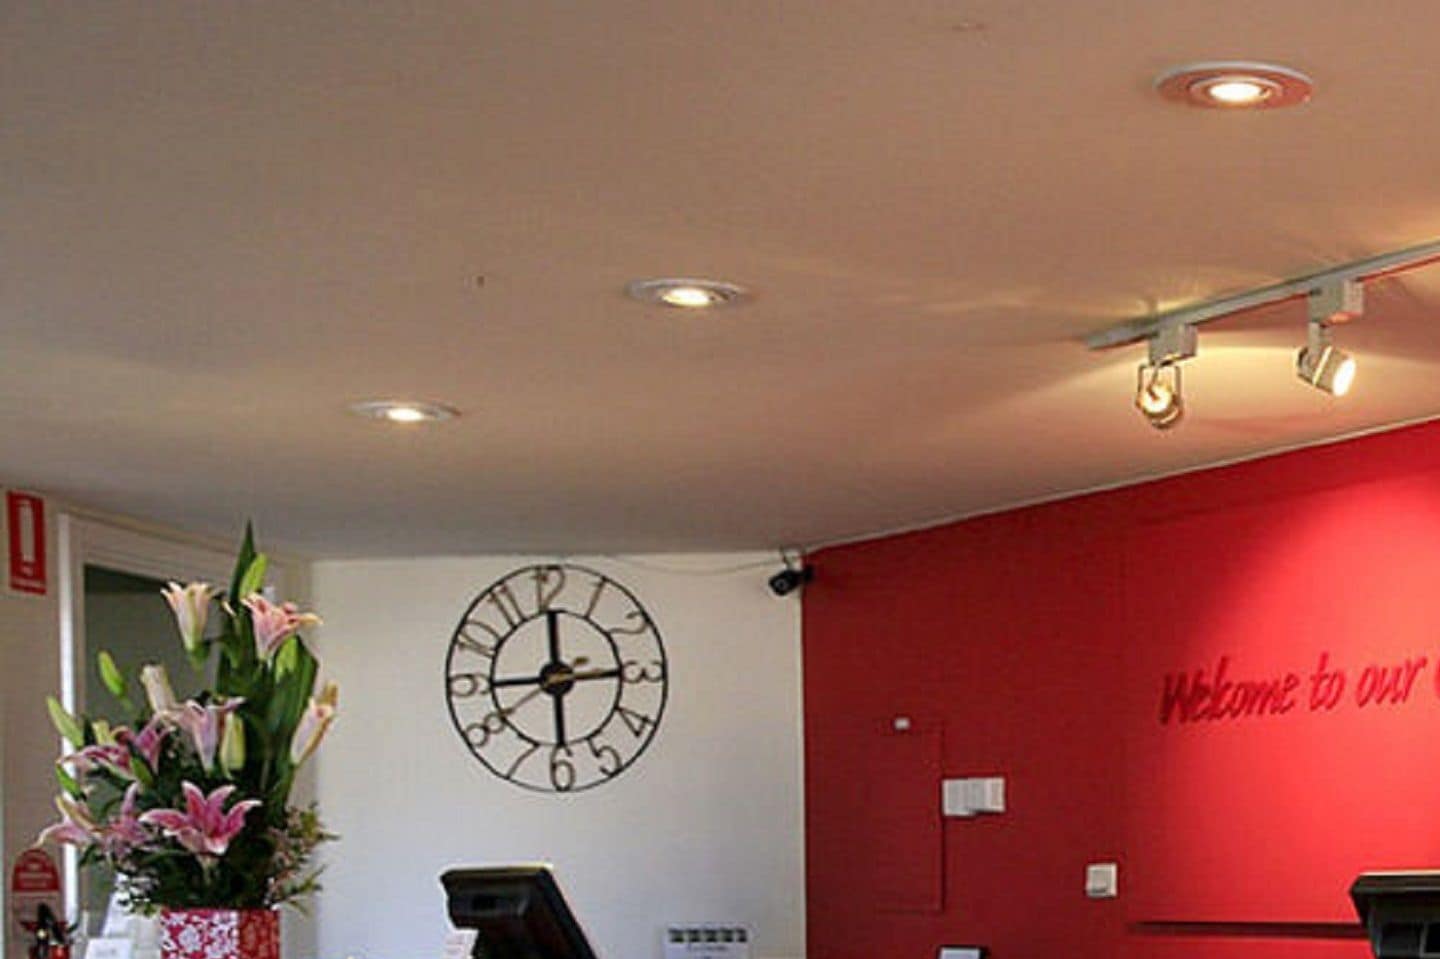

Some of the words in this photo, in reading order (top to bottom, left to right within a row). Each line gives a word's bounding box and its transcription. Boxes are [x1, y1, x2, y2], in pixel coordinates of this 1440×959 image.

[489, 584, 528, 629] 11
[532, 566, 565, 612] 12
[585, 577, 607, 619] 1
[456, 619, 502, 660] 10
[607, 611, 652, 635] 2
[447, 672, 492, 697] 9
[621, 660, 665, 684] 3
[1158, 656, 1300, 725] Welcome
[1308, 650, 1346, 712] to
[1356, 656, 1427, 708] our
[465, 711, 506, 748] 8
[615, 705, 656, 738] 4
[505, 742, 541, 781] 7
[550, 744, 576, 792] 6
[586, 738, 622, 777] 5
